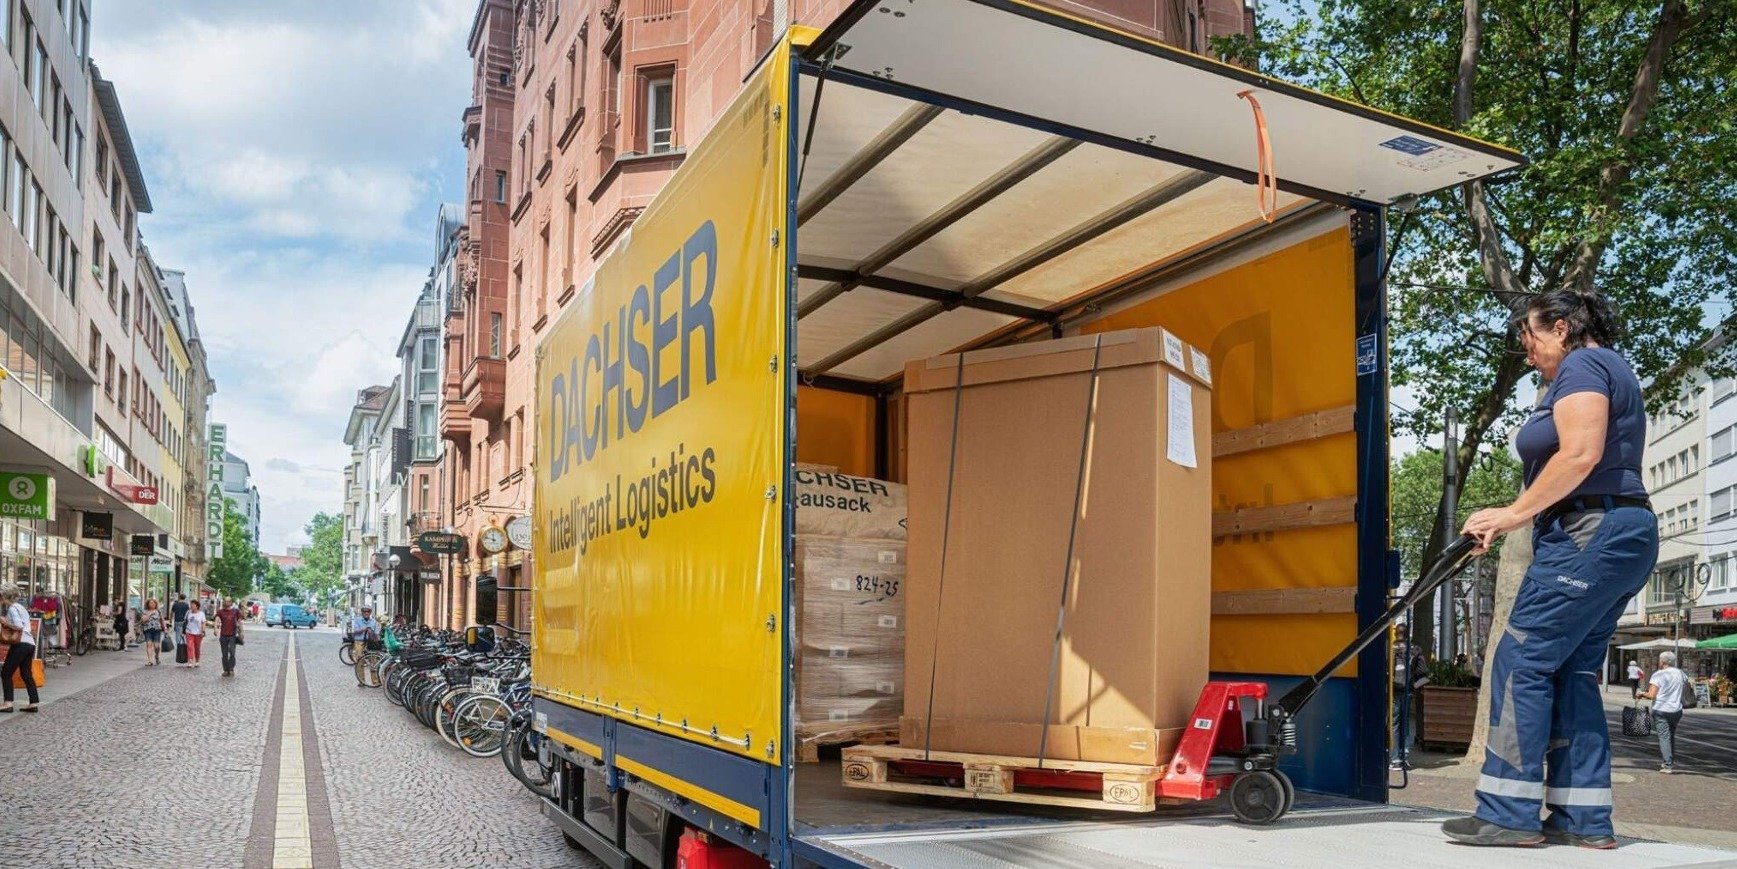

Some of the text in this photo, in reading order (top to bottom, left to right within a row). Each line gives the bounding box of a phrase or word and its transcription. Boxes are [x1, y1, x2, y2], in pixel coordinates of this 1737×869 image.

[551, 219, 717, 482] DACHSER
[208, 425, 225, 562] ERHARDT
[549, 443, 717, 556] Intelligent Logistics
[2, 503, 42, 515] OXFAM
[855, 574, 899, 597] 824-25
[1557, 575, 1589, 590] DACHSER
[1114, 787, 1135, 799] EPAL
